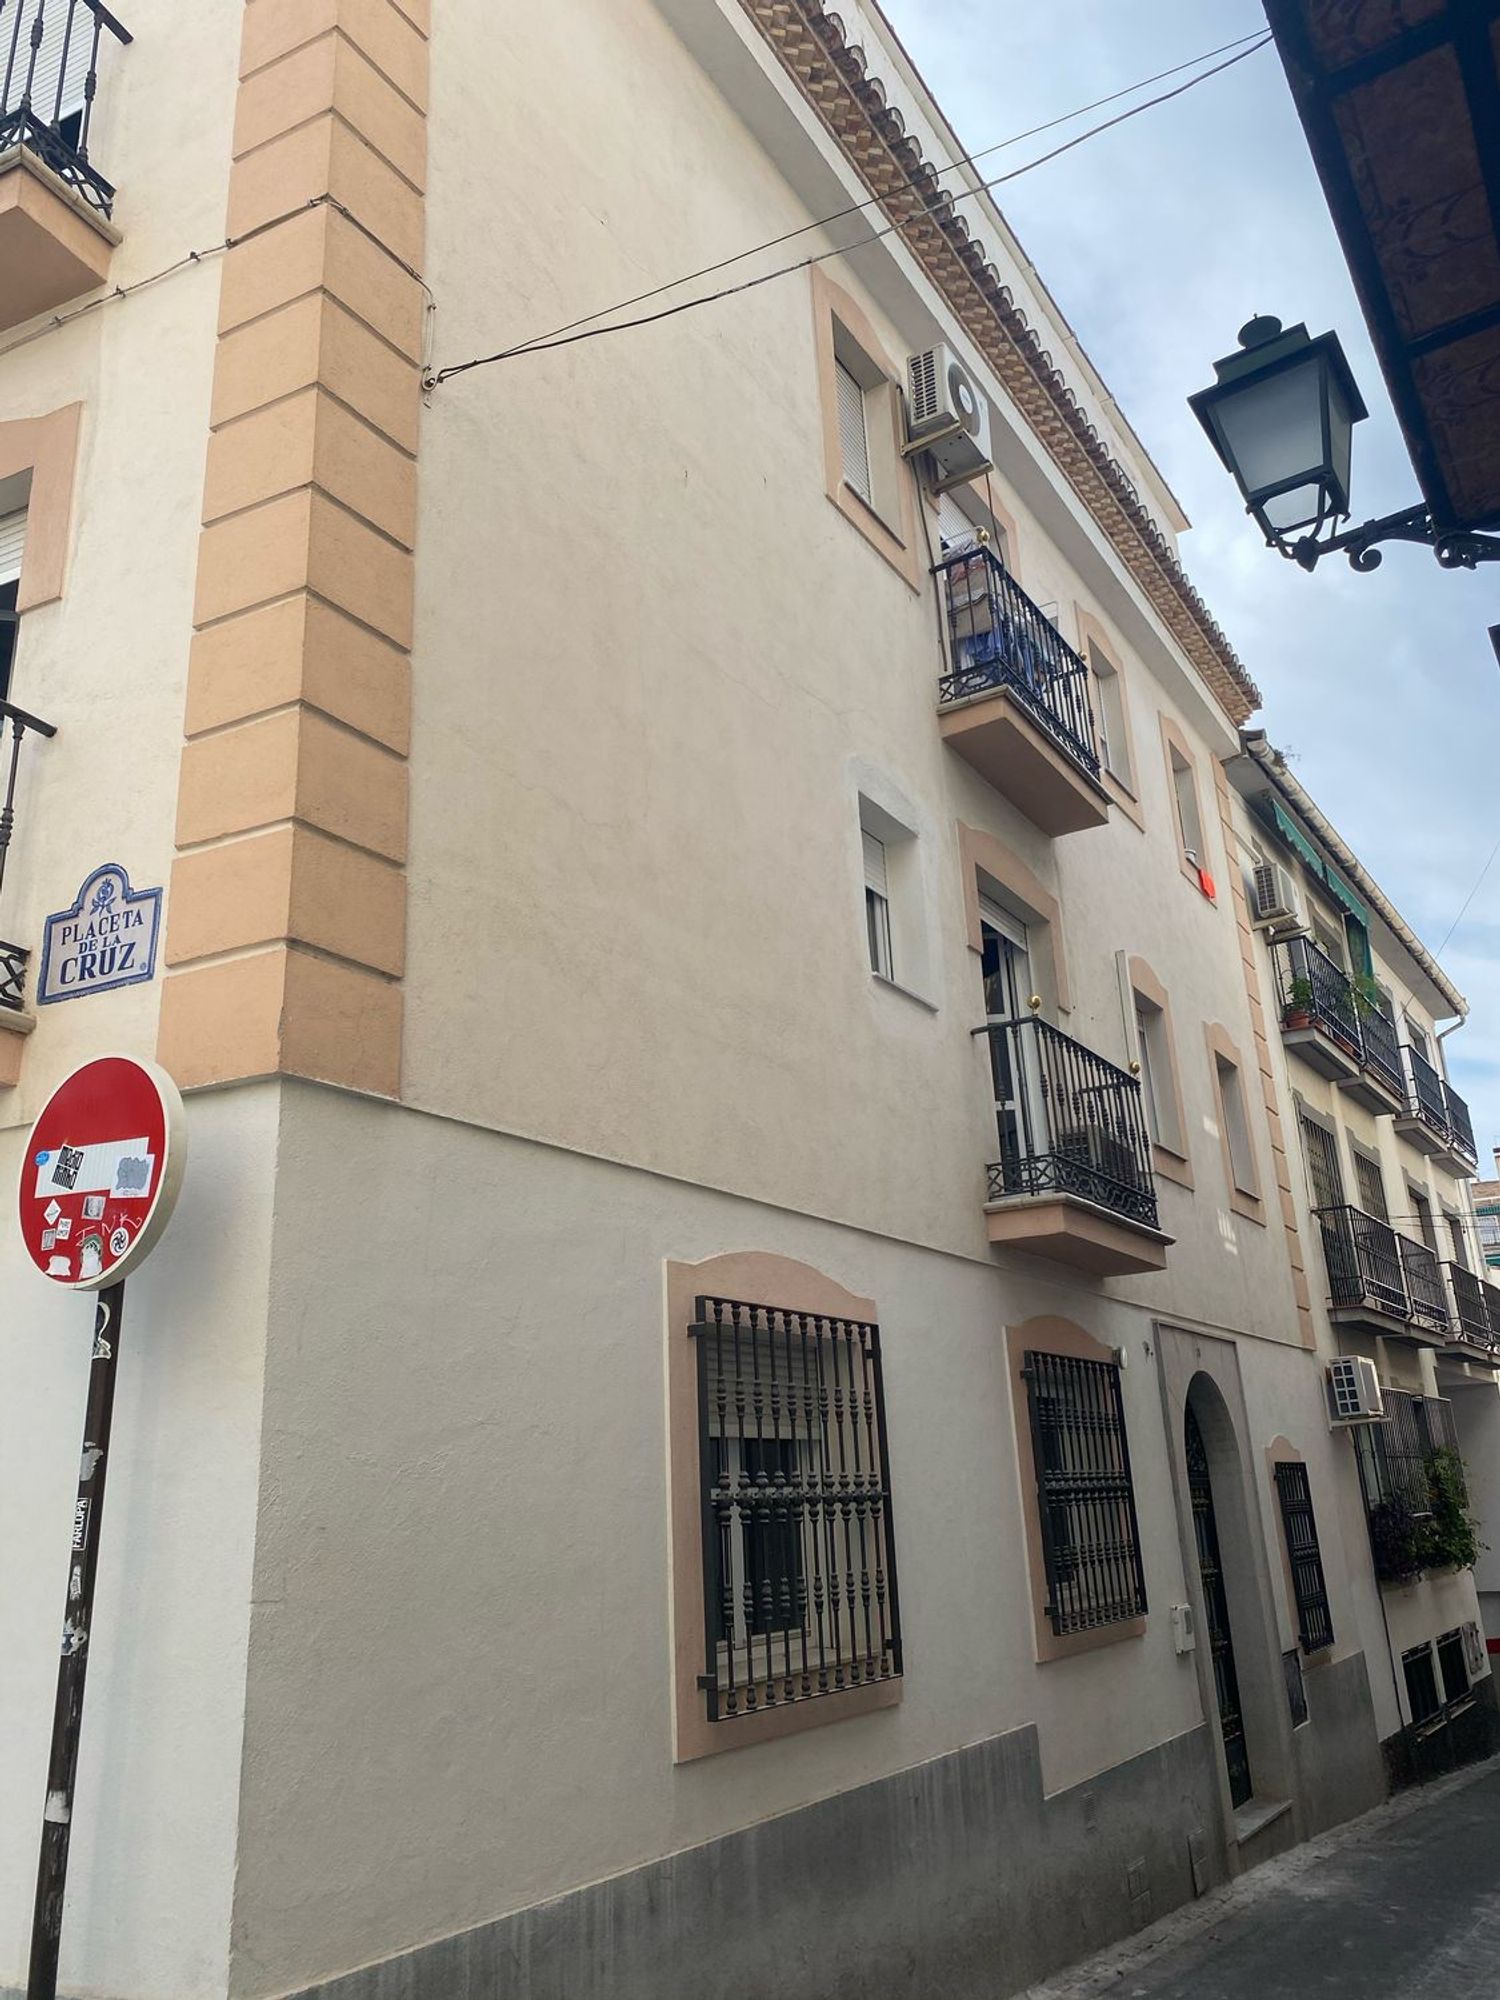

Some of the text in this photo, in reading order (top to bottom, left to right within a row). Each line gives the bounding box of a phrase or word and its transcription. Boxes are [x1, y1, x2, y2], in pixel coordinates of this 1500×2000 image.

[62, 909, 143, 945] PLACETA
[79, 935, 121, 953] DE LA
[61, 942, 136, 984] CRUZ
